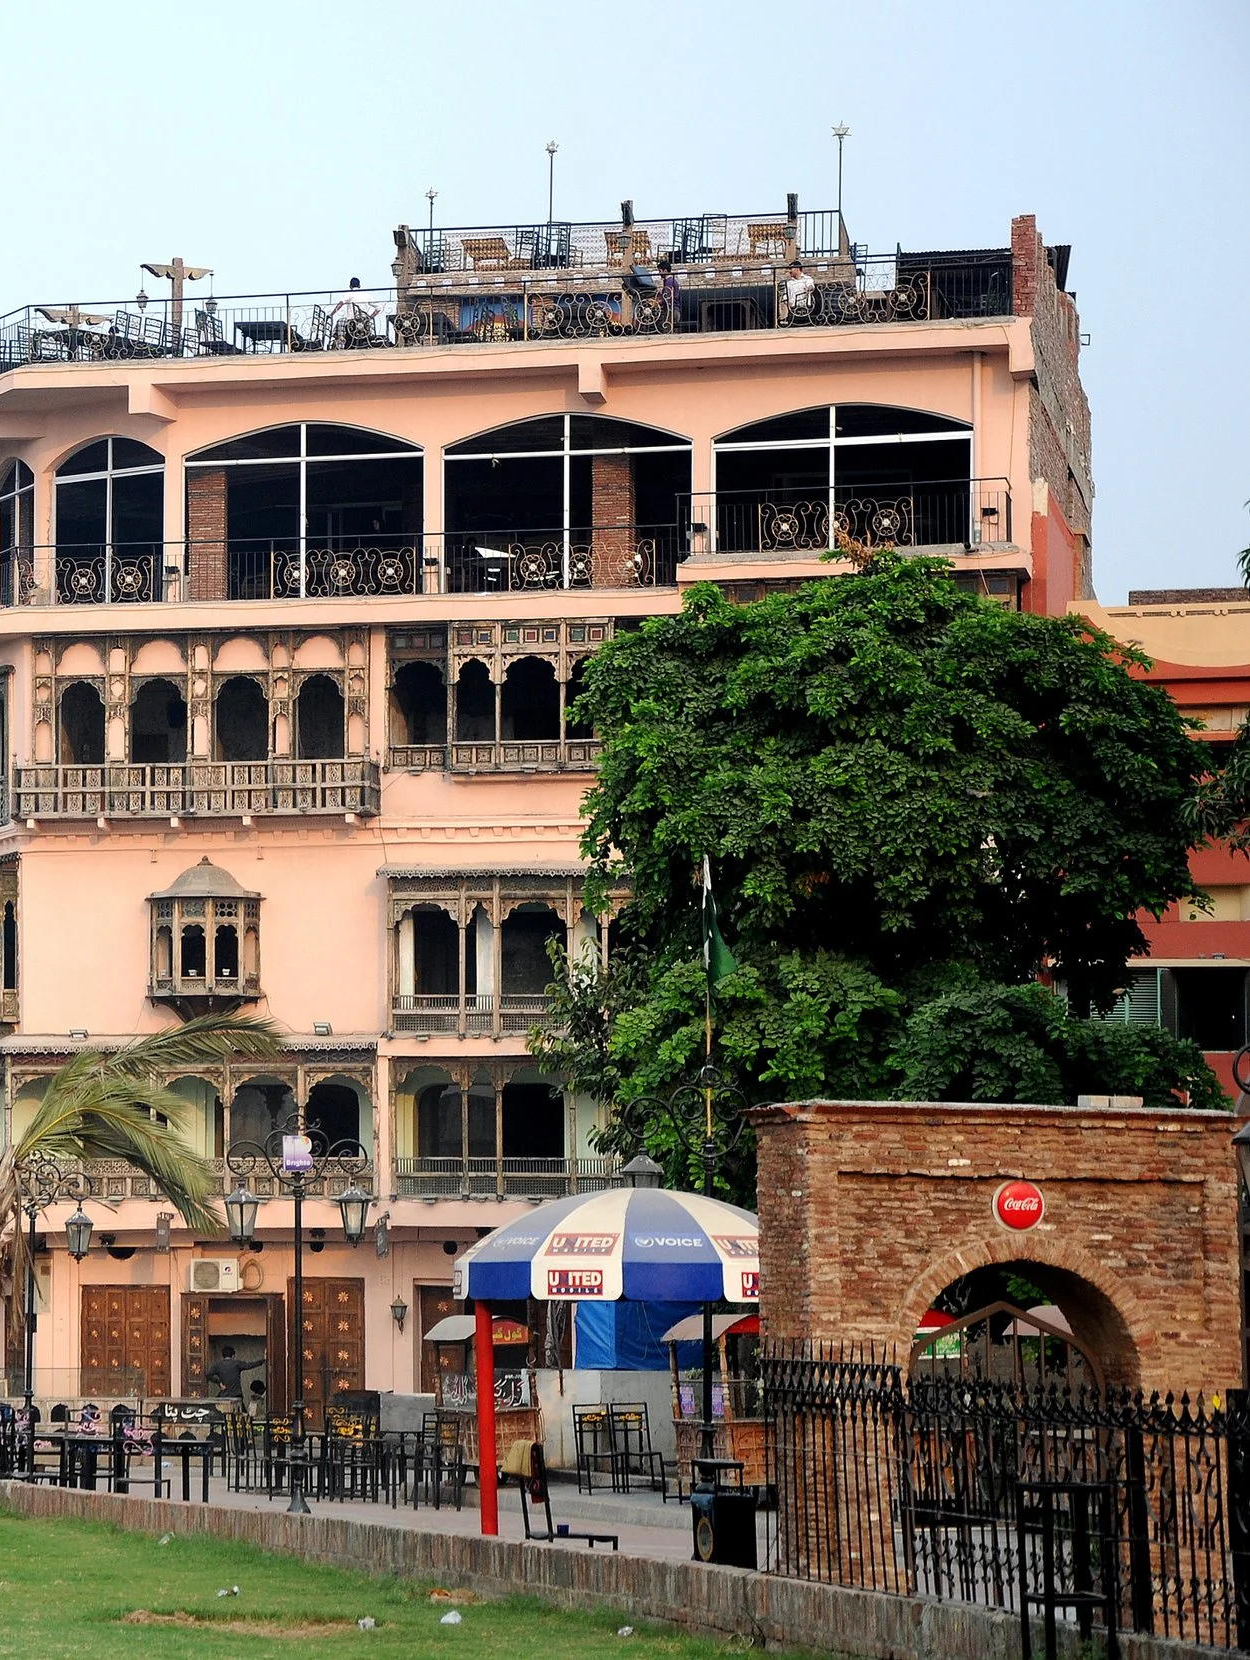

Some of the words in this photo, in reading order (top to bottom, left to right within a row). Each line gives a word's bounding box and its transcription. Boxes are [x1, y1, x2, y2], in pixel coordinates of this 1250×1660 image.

[286, 1159, 311, 1168] Brighto
[552, 1236, 614, 1248] UNITED
[654, 1238, 703, 1248] VOICE
[548, 1271, 602, 1287] UNITED
